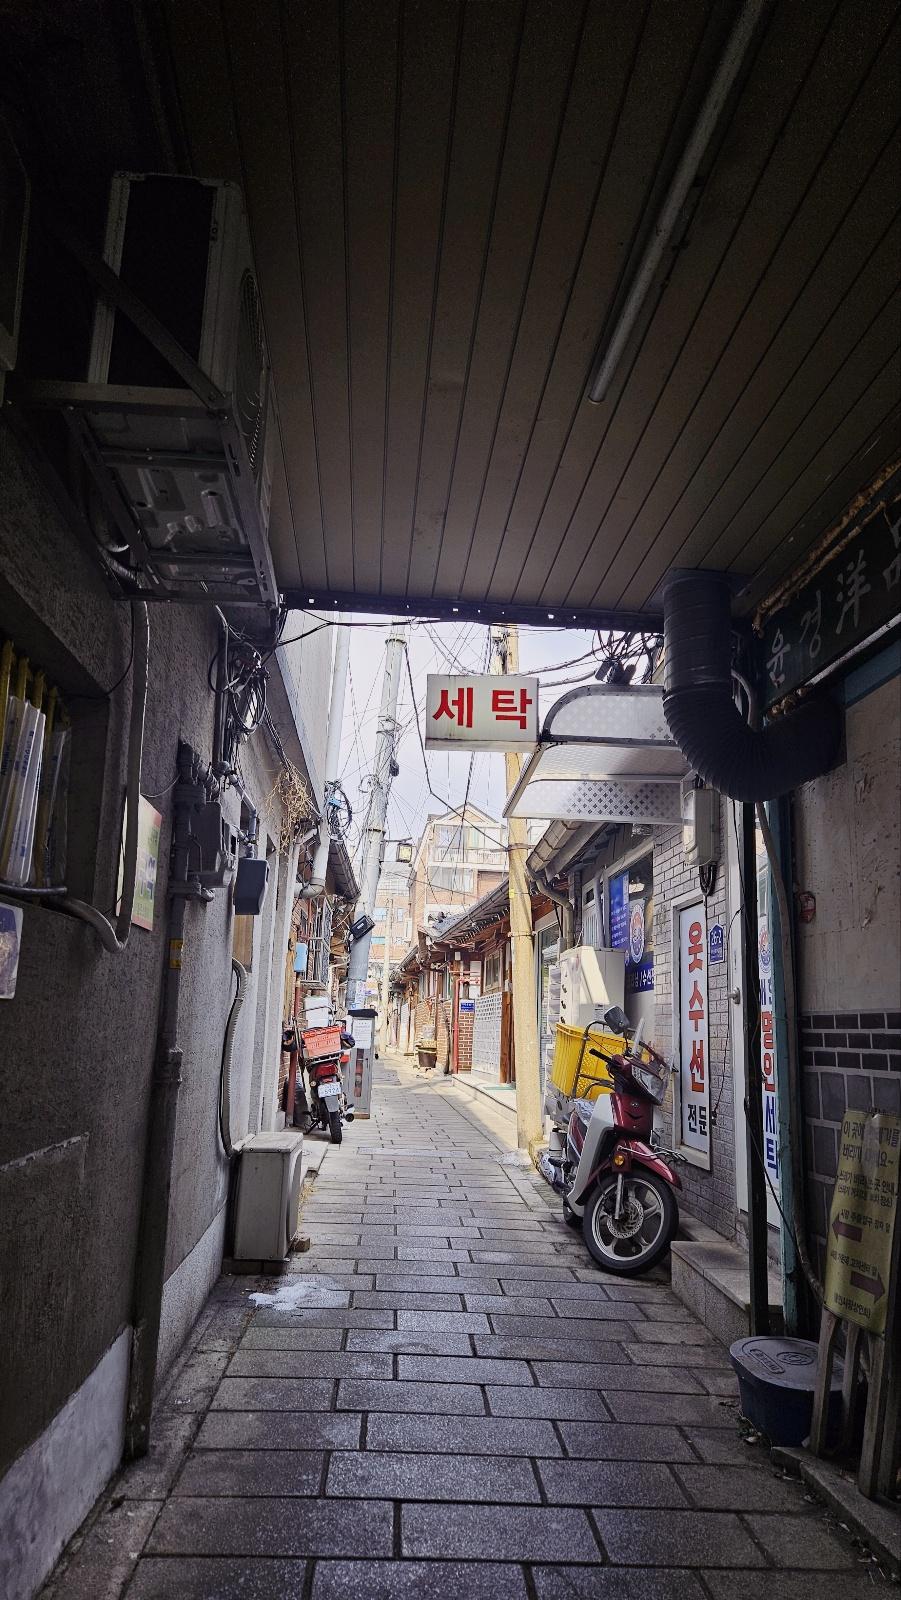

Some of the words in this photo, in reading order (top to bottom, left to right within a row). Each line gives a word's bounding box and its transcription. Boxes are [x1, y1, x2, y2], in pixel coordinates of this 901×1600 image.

[433, 686, 533, 730] 세탁
[711, 930, 722, 946] 26-2
[687, 1103, 707, 1136] 전문
